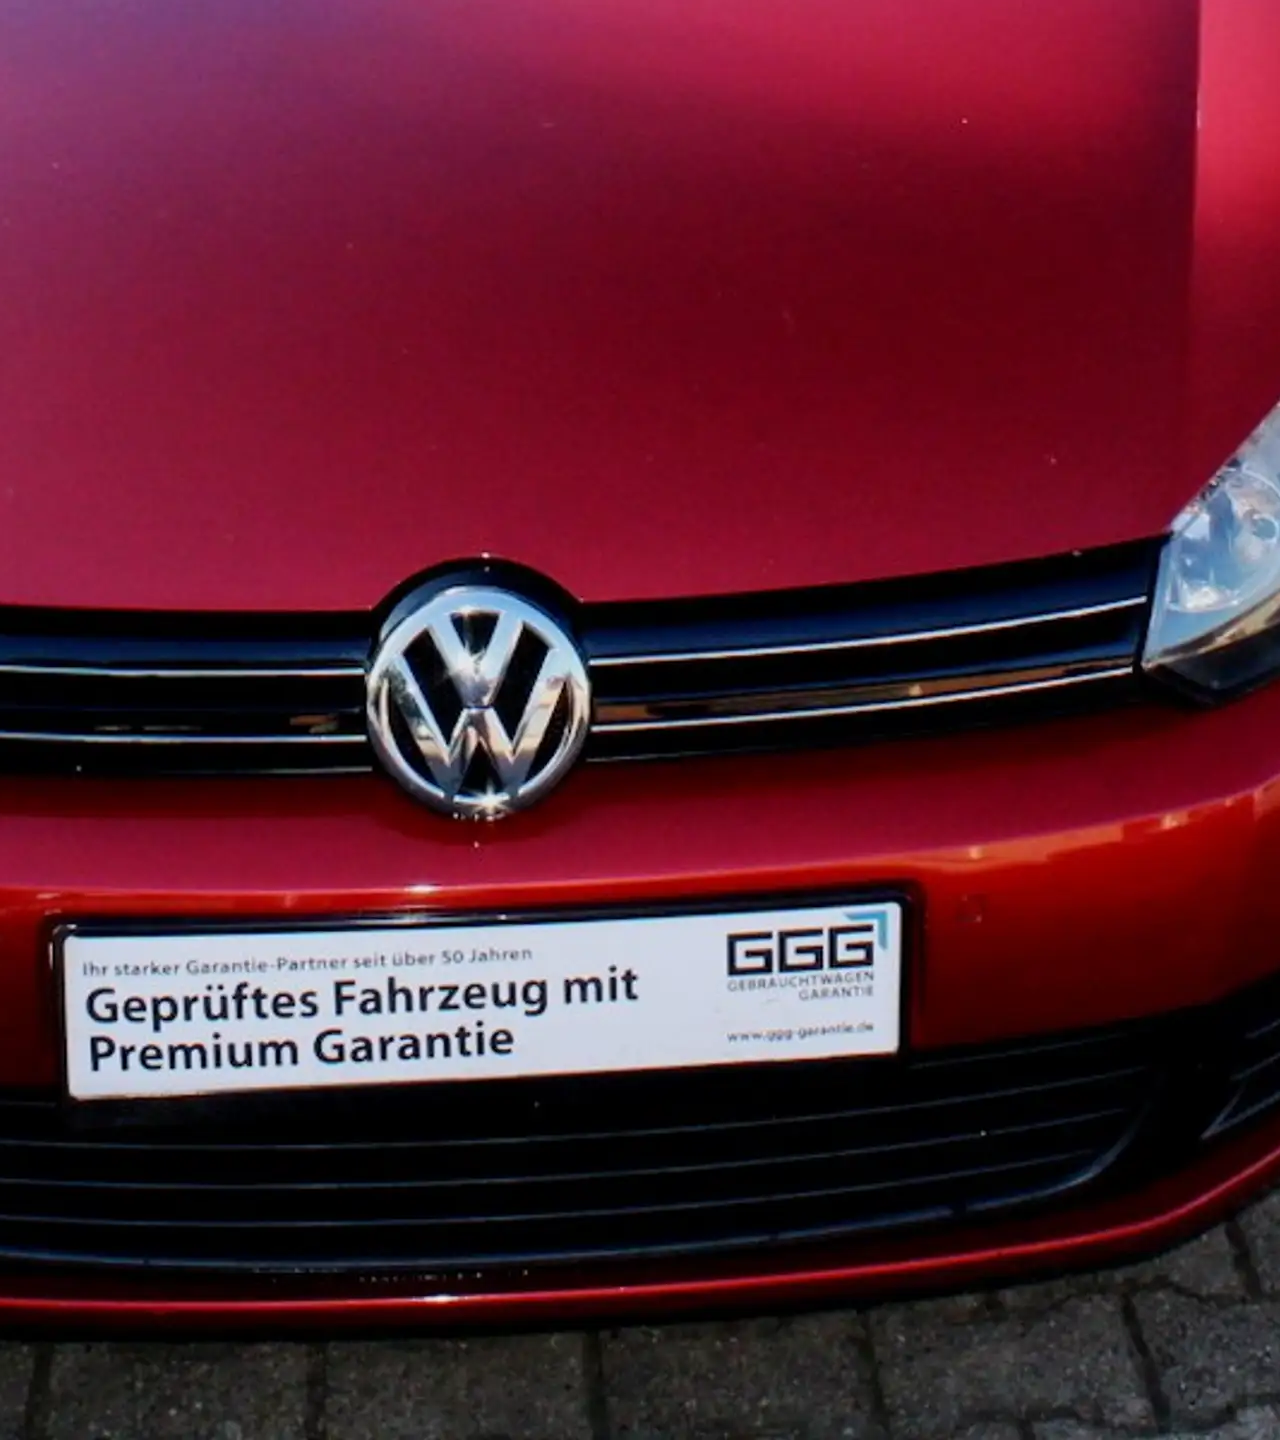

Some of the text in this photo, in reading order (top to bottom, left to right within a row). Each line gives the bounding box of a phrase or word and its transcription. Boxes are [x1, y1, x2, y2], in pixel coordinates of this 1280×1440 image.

[82, 947, 533, 976] Ihr starker Garantie-Partner seit über 50 Jahren
[727, 924, 874, 976] GGG
[86, 964, 639, 1033] Geprüftes Fahrzeug mit
[727, 972, 874, 992] GEBRAUCHTWAGEN
[798, 985, 874, 1002] GARANTIE
[89, 1020, 515, 1072] Premium Garantie
